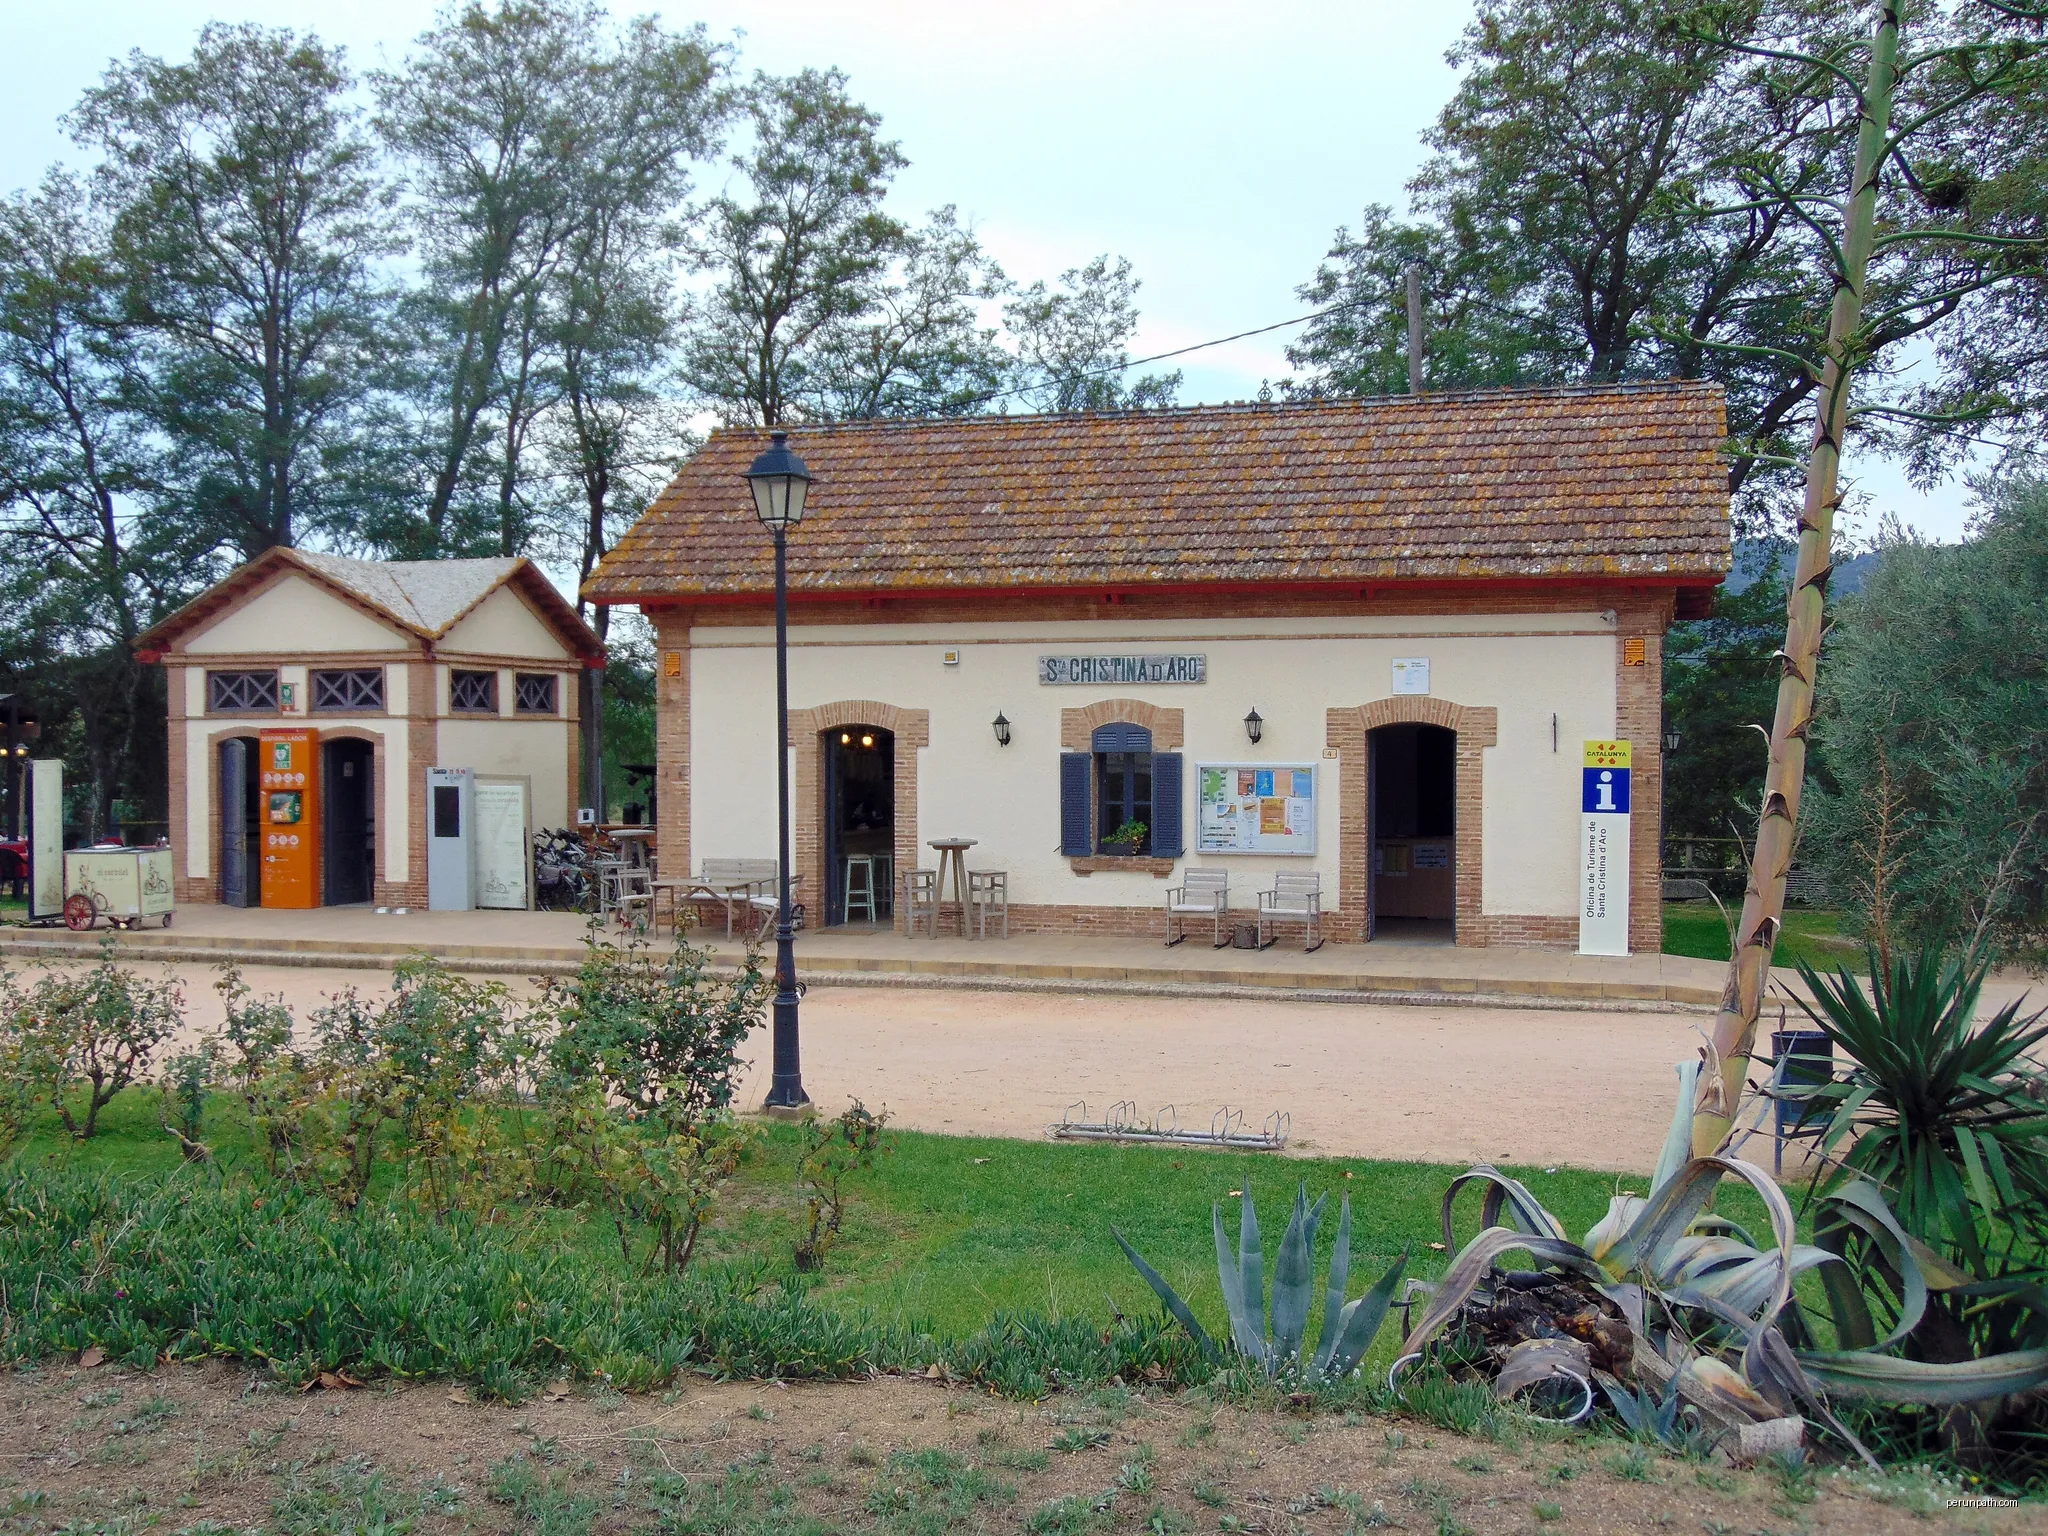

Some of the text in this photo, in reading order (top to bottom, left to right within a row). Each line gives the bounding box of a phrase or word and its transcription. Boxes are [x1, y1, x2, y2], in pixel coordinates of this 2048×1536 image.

[1069, 657, 1148, 682] CRISTINA
[1586, 820, 1596, 918] Oficina de Turisme de
[1597, 828, 1607, 918] Santa Cristina d'Aro
